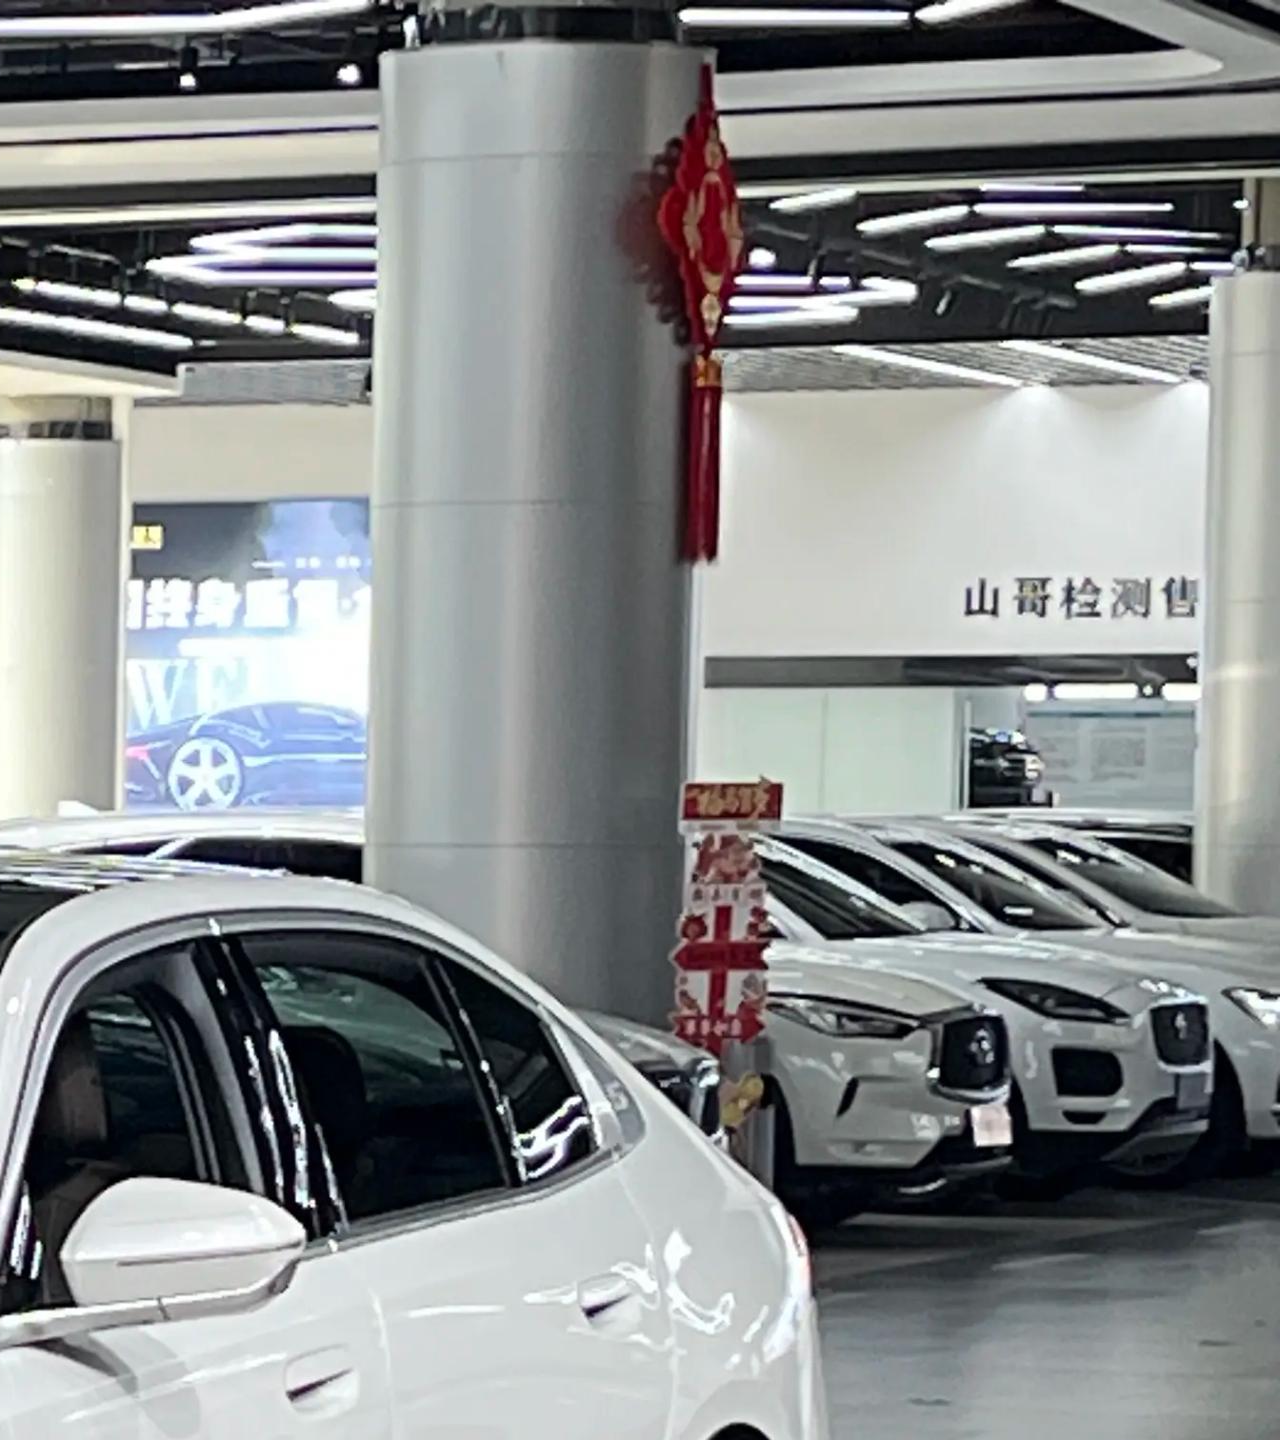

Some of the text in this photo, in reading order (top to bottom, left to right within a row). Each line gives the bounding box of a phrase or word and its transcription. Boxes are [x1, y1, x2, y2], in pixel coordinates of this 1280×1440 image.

[964, 576, 1200, 618] 山哥检测售
